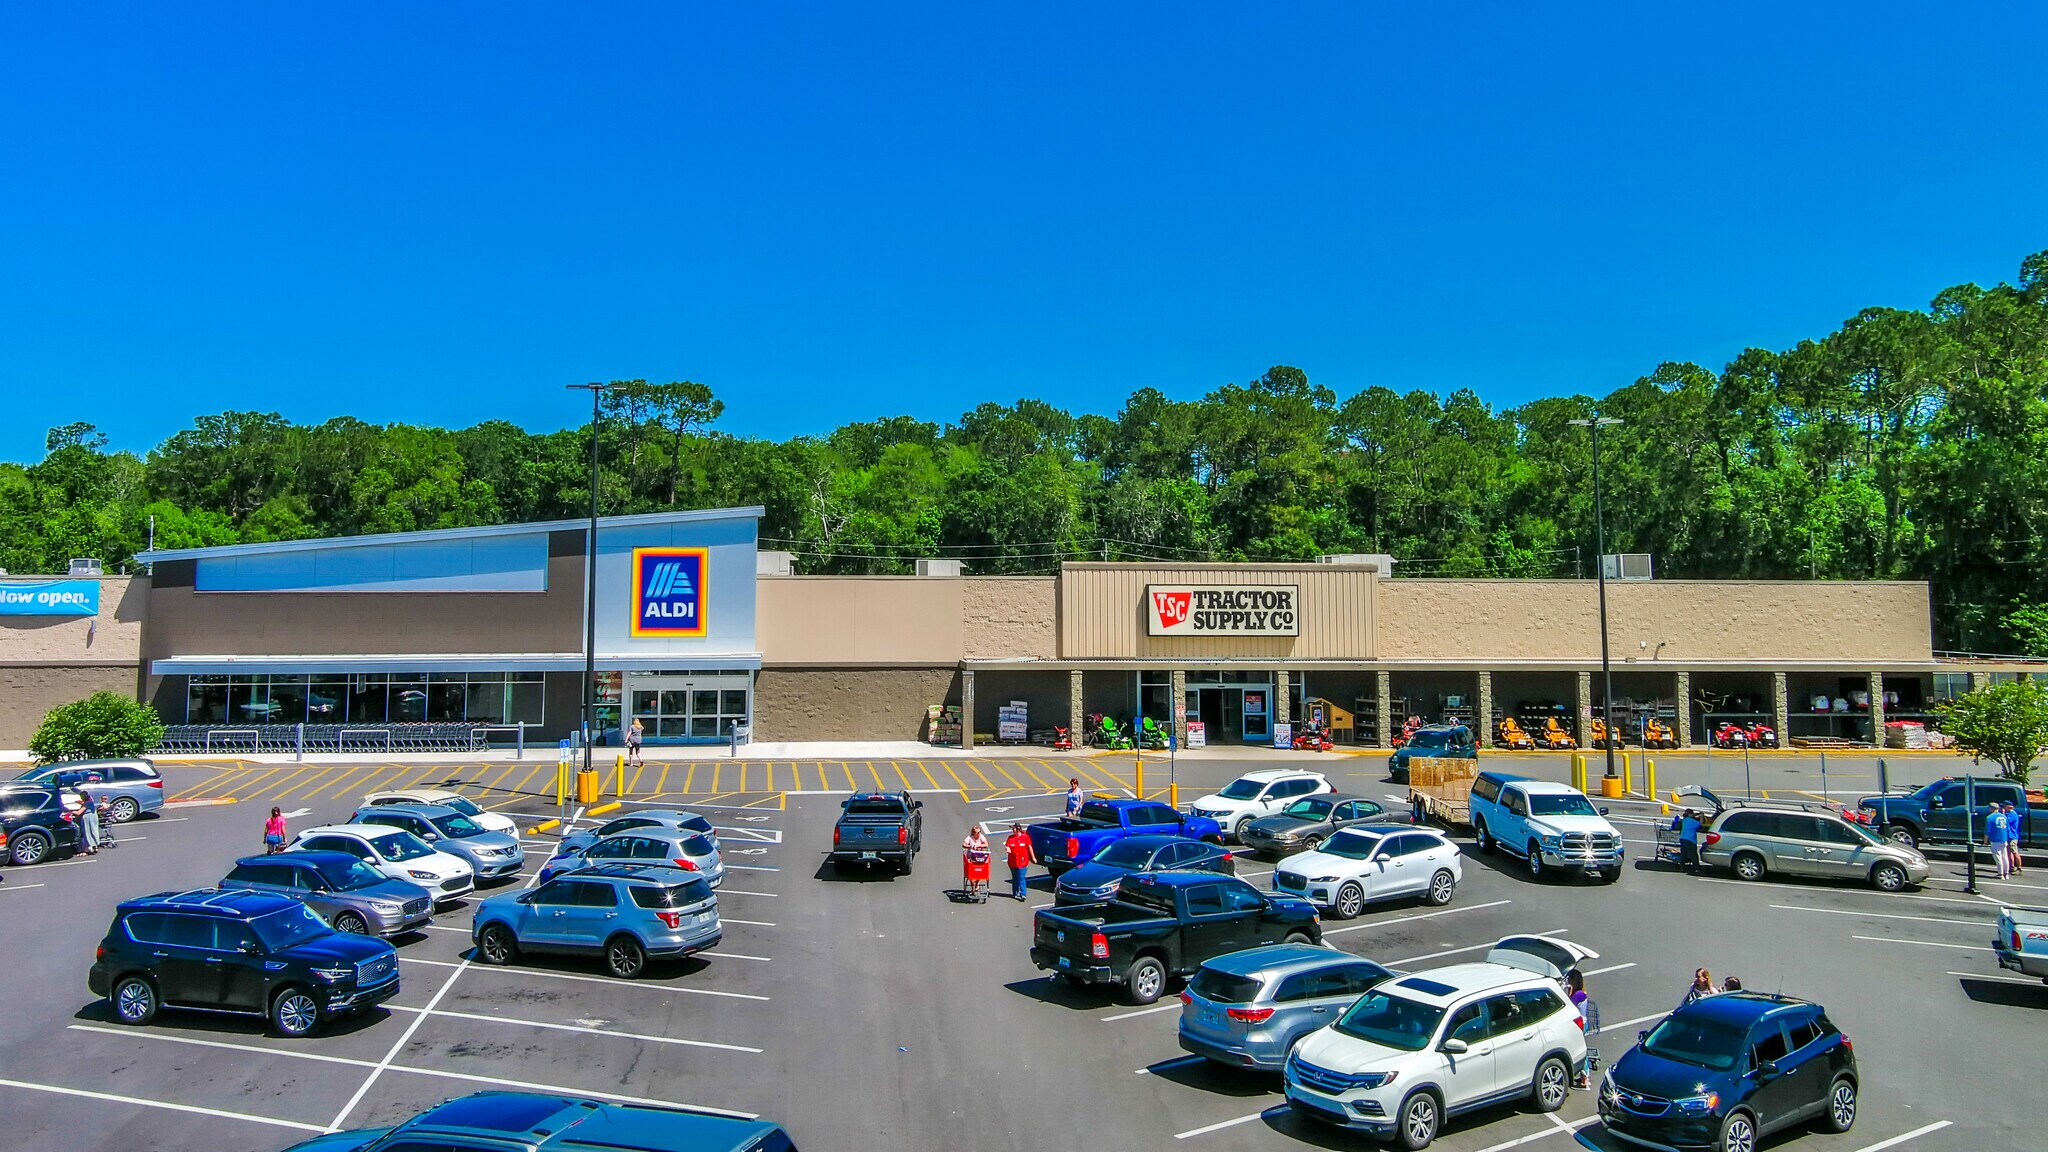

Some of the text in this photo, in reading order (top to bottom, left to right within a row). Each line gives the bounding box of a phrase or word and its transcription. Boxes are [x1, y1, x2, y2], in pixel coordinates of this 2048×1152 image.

[37, 591, 90, 607] open.
[1157, 593, 1186, 622] TSC
[1193, 590, 1293, 610] TRACTOR
[644, 602, 694, 618] ALDI
[1193, 611, 1268, 630] SUPPLY
